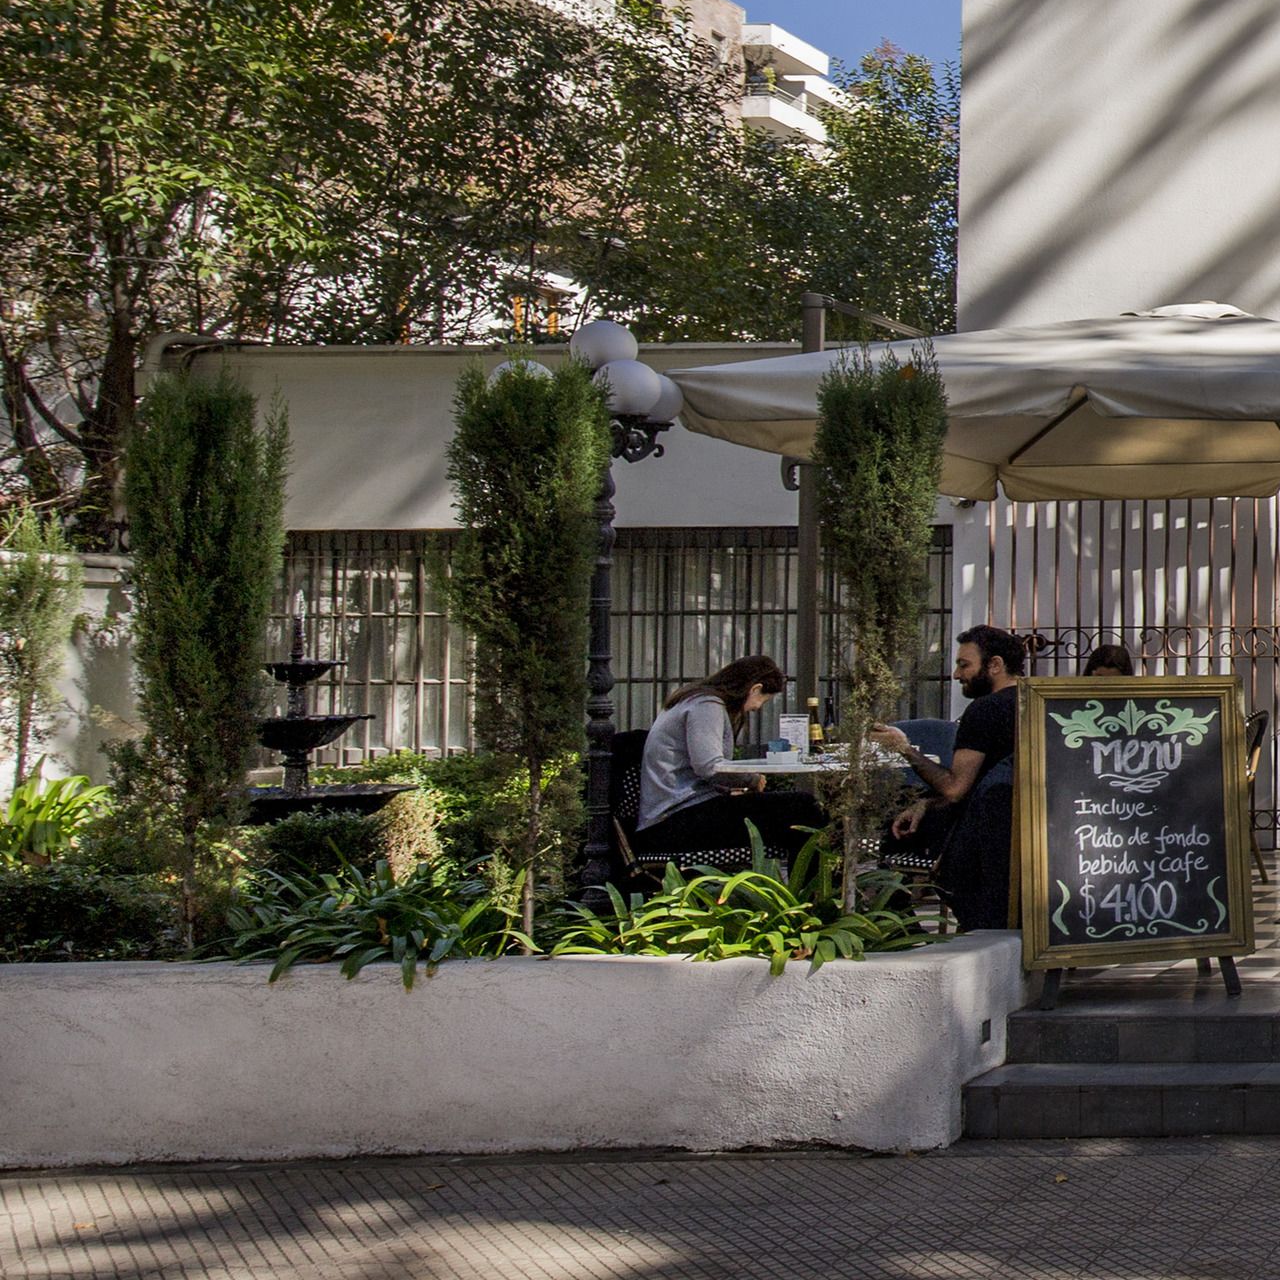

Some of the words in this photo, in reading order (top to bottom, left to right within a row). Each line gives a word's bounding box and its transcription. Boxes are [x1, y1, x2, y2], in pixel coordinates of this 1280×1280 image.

[1074, 824, 1123, 851] Plato
[1127, 825, 1150, 846] de
[1154, 824, 1210, 855] fondo
[1078, 850, 1139, 876] bebida
[1142, 859, 1156, 883] y
